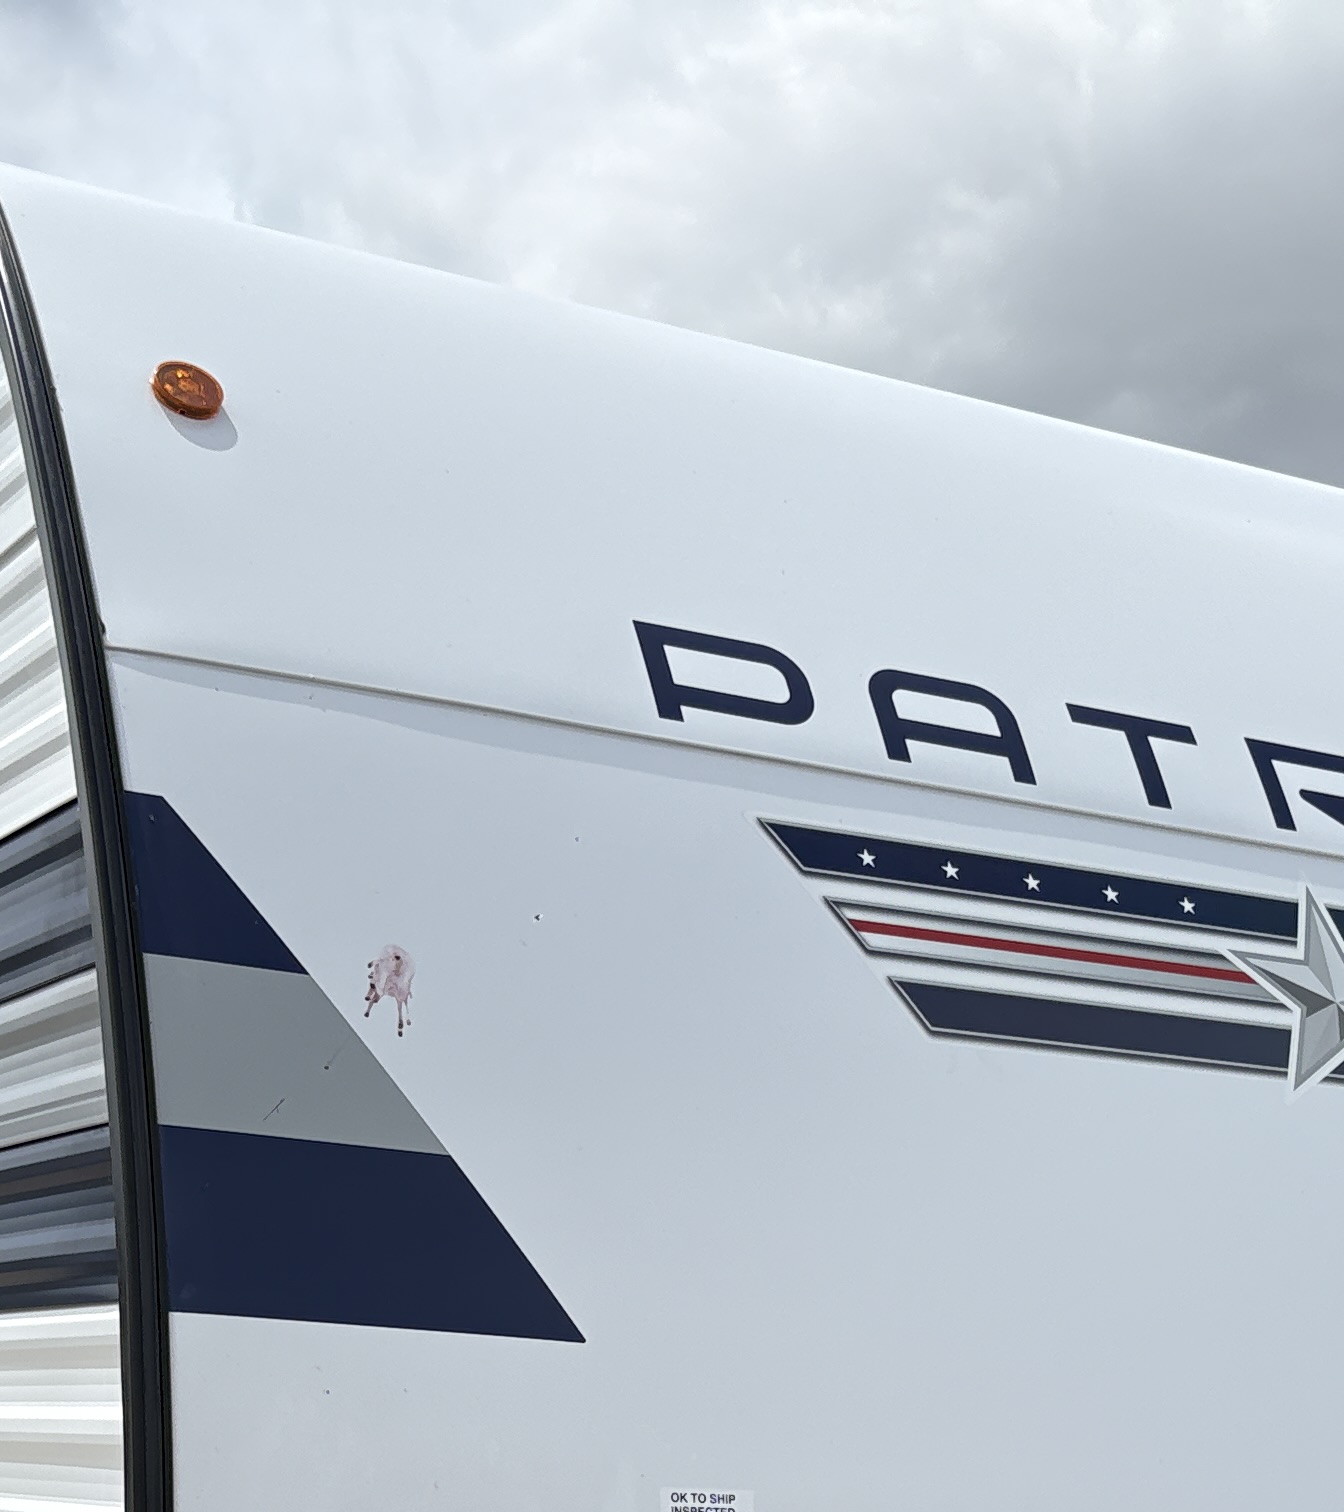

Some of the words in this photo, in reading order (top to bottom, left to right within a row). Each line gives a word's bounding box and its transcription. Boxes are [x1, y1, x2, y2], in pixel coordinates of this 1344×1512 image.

[670, 1492, 688, 1503] OK
[690, 1493, 706, 1504] TO
[709, 1494, 736, 1504] SHIP
